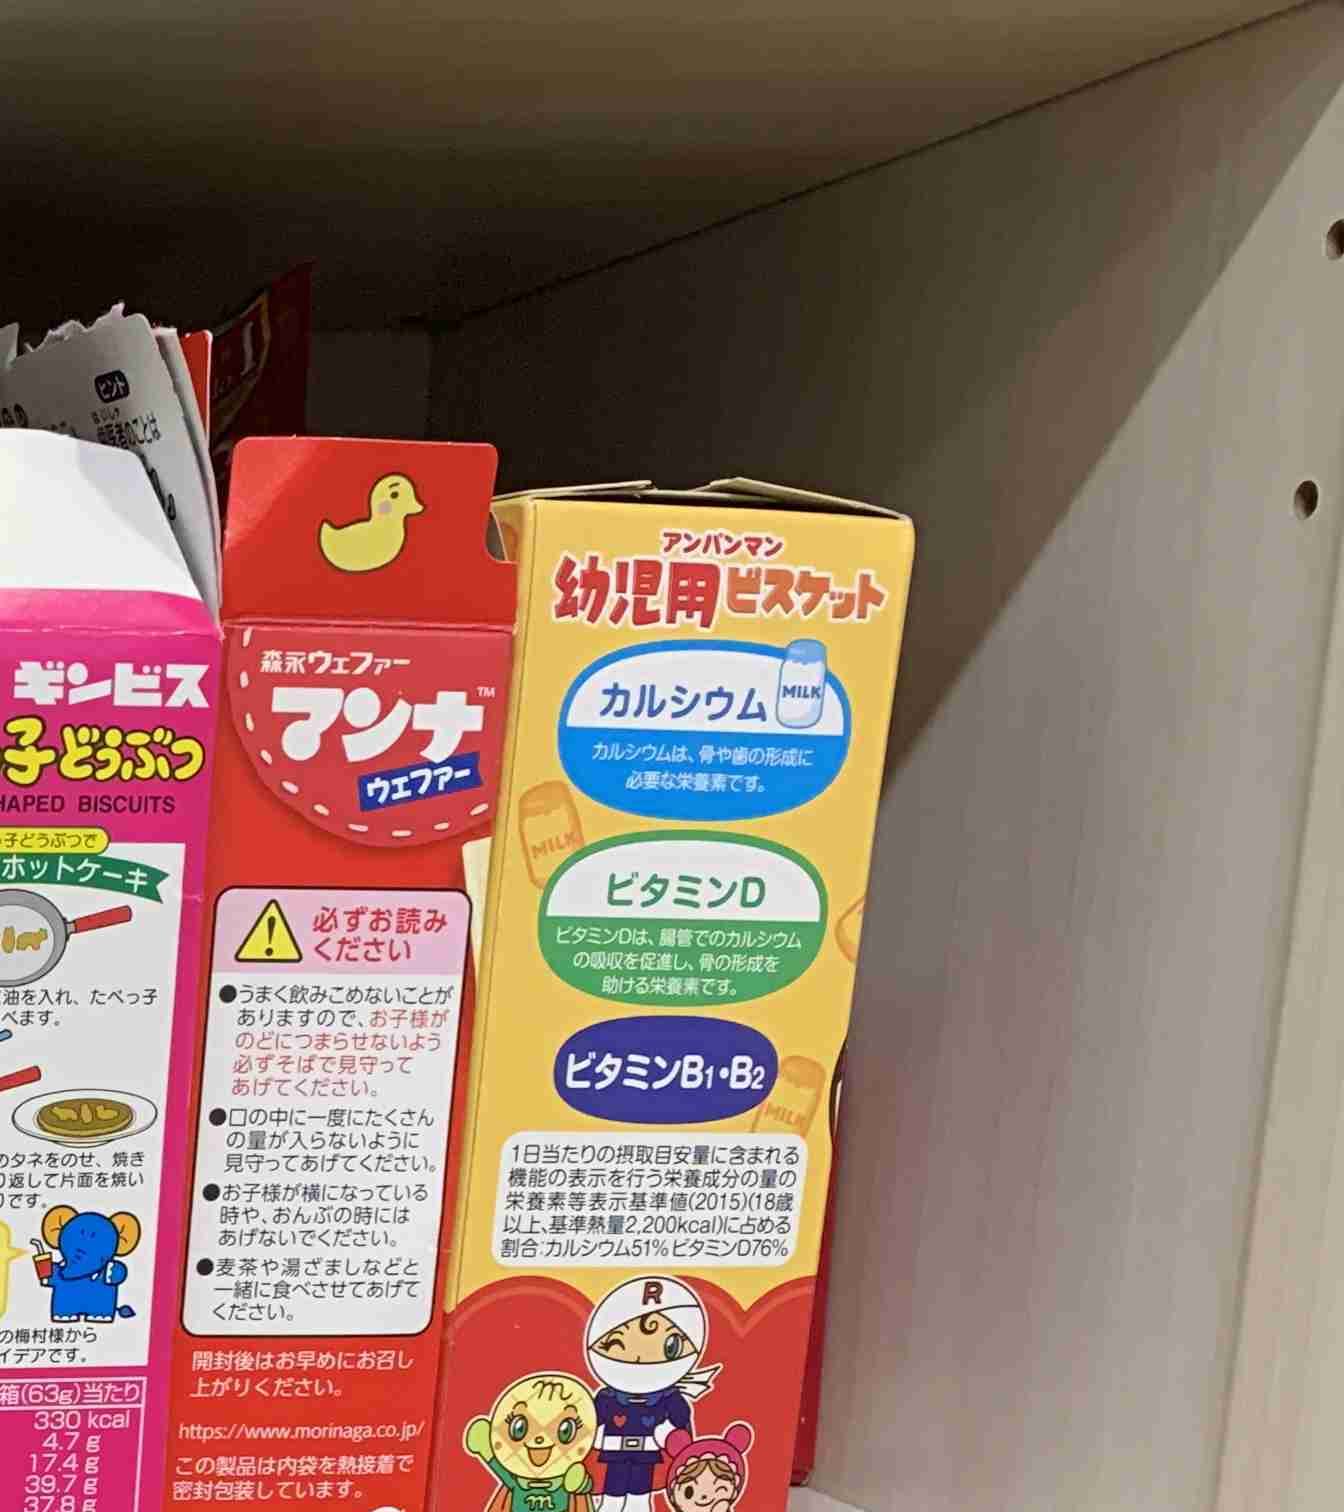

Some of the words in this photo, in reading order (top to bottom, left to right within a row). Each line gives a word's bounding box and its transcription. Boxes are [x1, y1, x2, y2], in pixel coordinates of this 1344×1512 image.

[662, 532, 783, 556] アンパンマン
[260, 649, 411, 676] 森永ウェファー
[13, 662, 209, 708] ギンビス
[782, 684, 821, 698] MILK
[599, 682, 767, 723] カルシウム
[271, 686, 485, 763] マンナ
[592, 741, 814, 768] カルシウムは、骨や歯の形成に
[366, 764, 472, 805] ウェファー
[625, 769, 766, 795] 必要な栄養素です。
[78, 795, 176, 814] BISCUITS
[606, 871, 765, 909] ビタミンD
[312, 906, 449, 935] 必ずお読み
[313, 936, 413, 963] ください
[573, 950, 779, 975] の吸収を促進し、骨の形成を
[237, 984, 453, 1006] うまく飲みこめないことが
[601, 976, 738, 998] 助ける栄養素です。
[236, 1008, 449, 1030] ありますので、お子様が
[235, 1032, 442, 1053] のどにつまらせないよう
[232, 1054, 412, 1076] 必ずそばで見守って
[231, 1078, 380, 1099] あげてください。
[229, 1107, 435, 1129] 口の中に一度にたくさん
[226, 1130, 421, 1151] の量が入らないように
[224, 1153, 438, 1176] 見守ってあげてください。
[511, 1144, 801, 1167] 1日当たりの摂取目安量に含まれる
[507, 1168, 797, 1189] 機能の表示を行う栄養成分の量の
[220, 1183, 429, 1203] お子様が横になっている
[219, 1205, 410, 1227] 時や、おんぶの時には
[218, 1228, 398, 1250] あげないでください。
[672, 1238, 789, 1259] ビタミンD76%
[215, 1257, 421, 1279] 麦茶や湯ざましなどと
[214, 1280, 419, 1301] 一緒に食べさせてあげて
[643, 1281, 664, 1305] R
[212, 1302, 296, 1323] ください。
[191, 1350, 413, 1374] 開封後はお早めにお召し
[190, 1377, 344, 1399] 上がりください。
[34, 1411, 80, 1429] 330
[87, 1410, 130, 1428] kcal
[178, 1420, 425, 1444] https://www.morinaga.co.jp/
[42, 1433, 79, 1451] 4.7
[85, 1435, 102, 1454] g
[28, 1455, 78, 1472] 17.4
[84, 1457, 100, 1476] g
[174, 1455, 414, 1477] この製品は内袋を熱接着で
[24, 1476, 77, 1494] 39.7
[82, 1478, 99, 1497] g
[172, 1480, 365, 1501] 密封包装しています。
